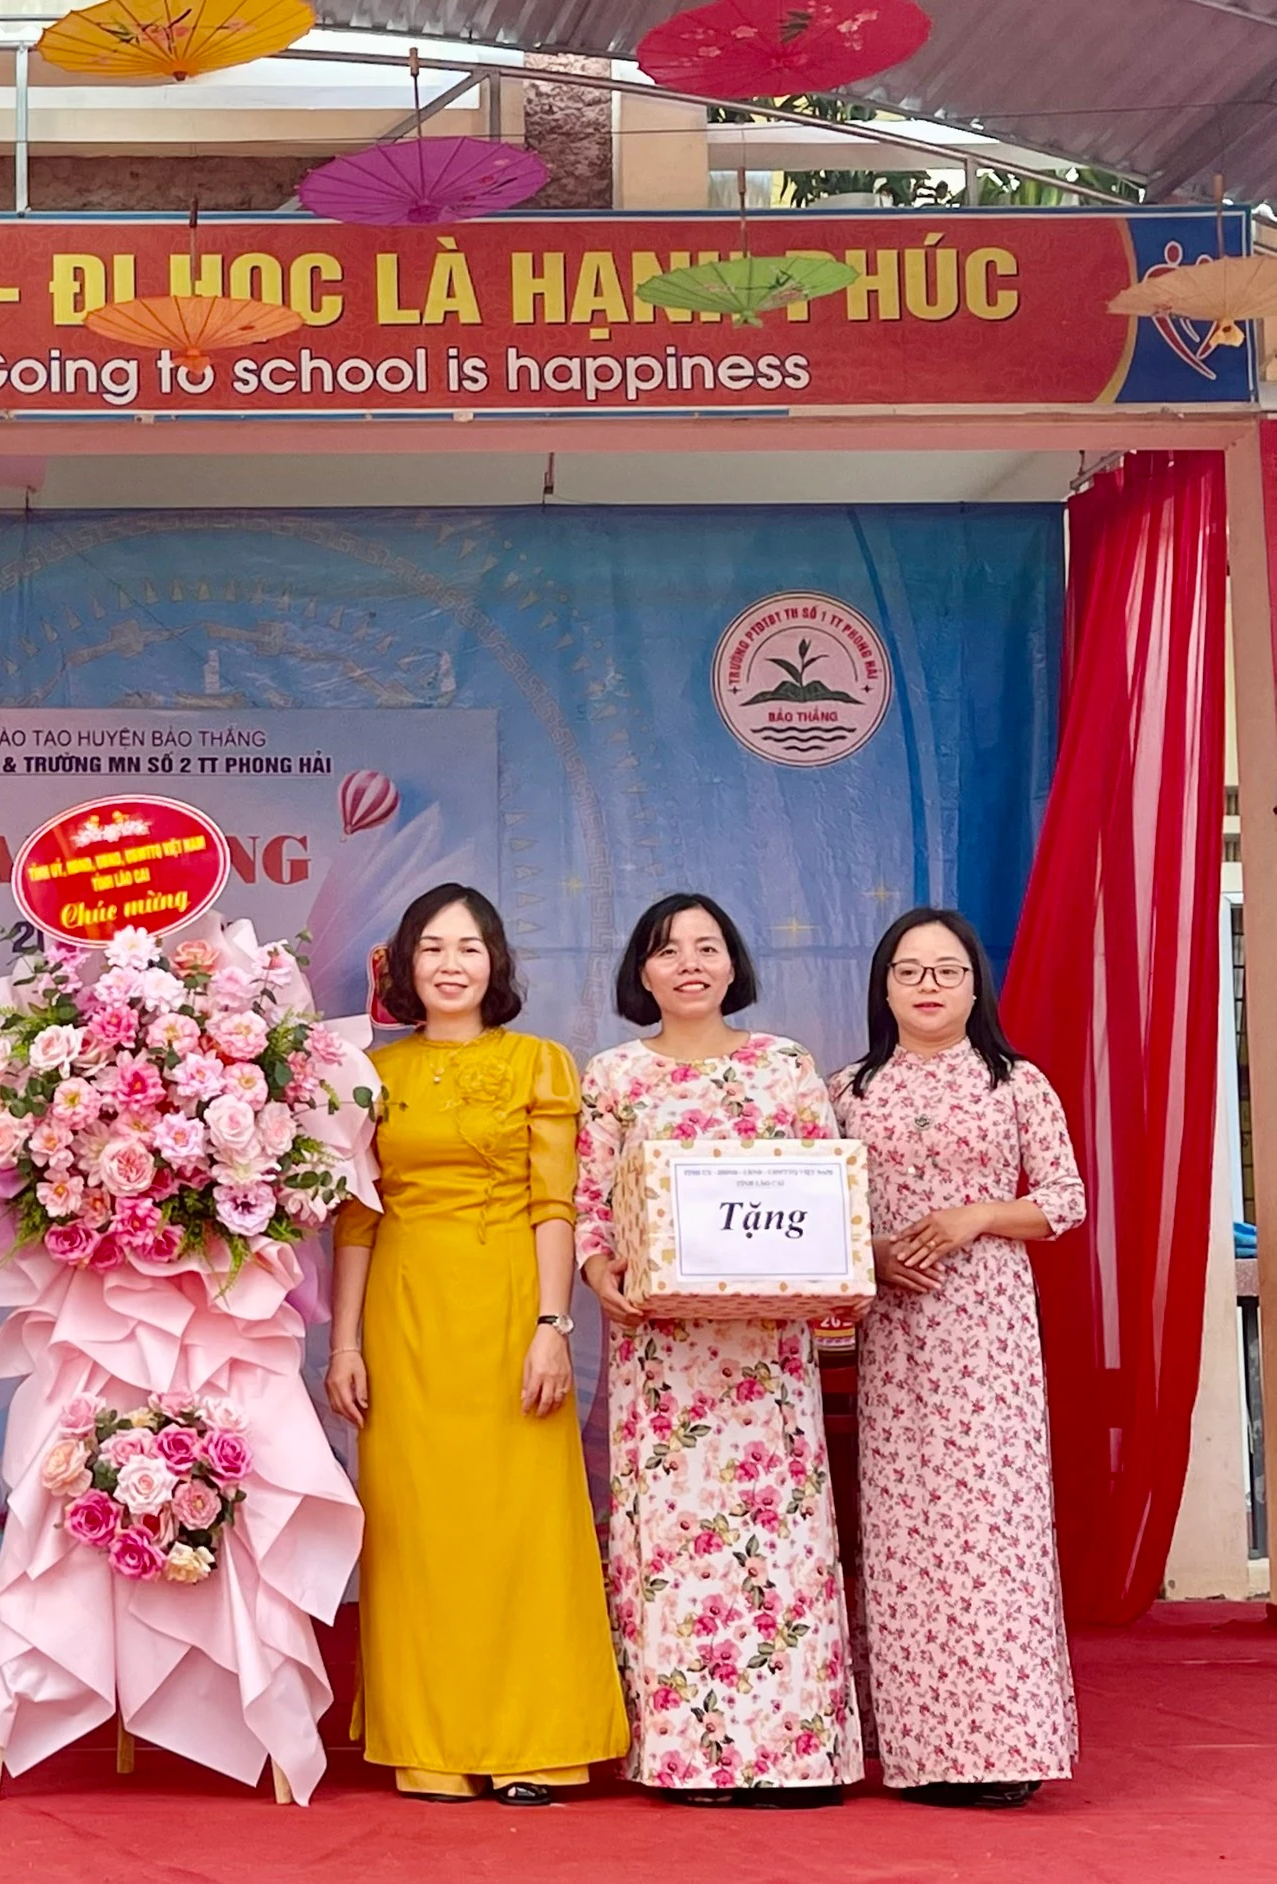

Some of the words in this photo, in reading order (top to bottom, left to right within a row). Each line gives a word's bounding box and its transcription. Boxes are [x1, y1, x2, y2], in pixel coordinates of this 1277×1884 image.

[49, 253, 135, 326] ĐI
[376, 236, 481, 325] LÀ
[157, 349, 215, 394] to
[233, 348, 427, 394] school
[448, 348, 489, 392] is
[506, 346, 811, 401] happiness
[783, 608, 799, 621] TH
[842, 623, 873, 659] PHONG
[78, 727, 145, 750] HUYỆN
[152, 725, 193, 747] BẢO
[2, 756, 17, 773] &
[23, 752, 102, 773] TRƯỜNG
[108, 756, 141, 773] MN
[147, 751, 174, 773] SỐ
[180, 757, 192, 773] 2
[198, 757, 219, 773] TT
[225, 757, 292, 773] PHONG
[299, 750, 331, 773] HẢI
[61, 900, 118, 929] Chúc
[123, 890, 189, 918] mừng
[719, 1201, 808, 1239] Tặng
